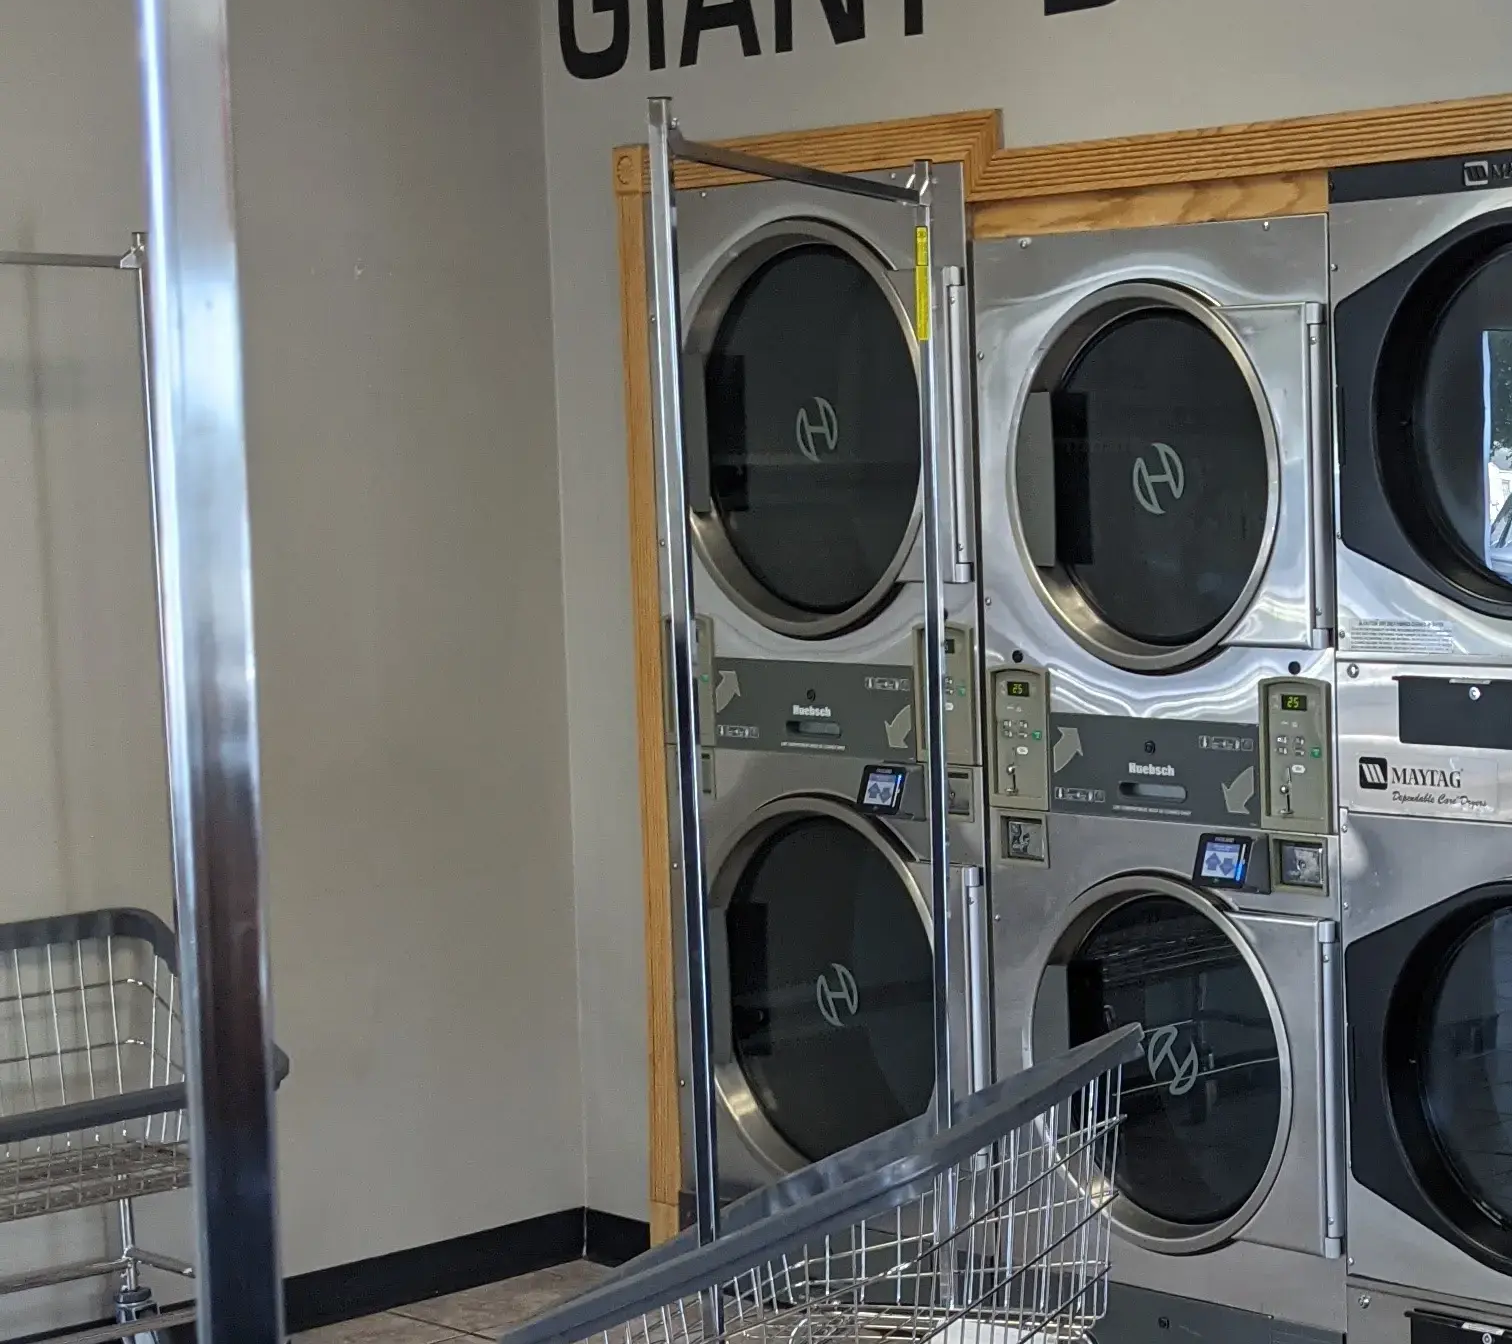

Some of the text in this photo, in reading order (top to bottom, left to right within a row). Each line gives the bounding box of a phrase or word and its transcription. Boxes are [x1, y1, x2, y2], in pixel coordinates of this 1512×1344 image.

[1286, 696, 1299, 709] 25
[1128, 762, 1175, 777] Huebsch
[1391, 767, 1462, 789] MAYTAG
[1392, 790, 1435, 808] Dependable
